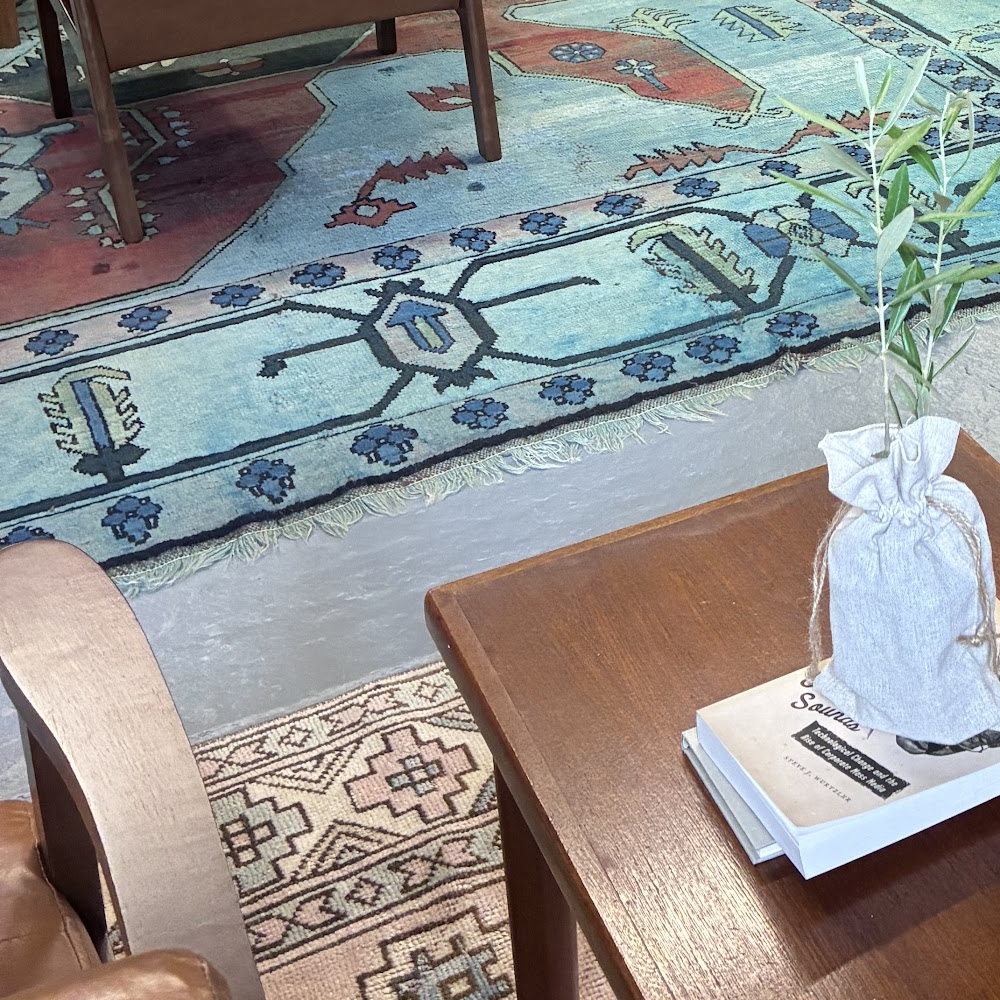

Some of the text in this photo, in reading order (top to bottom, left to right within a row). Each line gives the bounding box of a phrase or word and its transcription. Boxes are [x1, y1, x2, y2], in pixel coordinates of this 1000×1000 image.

[783, 755, 806, 773] STEVE
[813, 775, 853, 803] WURTZLER
[799, 734, 887, 793] Rise of Corporate Mass Media
[811, 727, 899, 787] Technological Change and the
